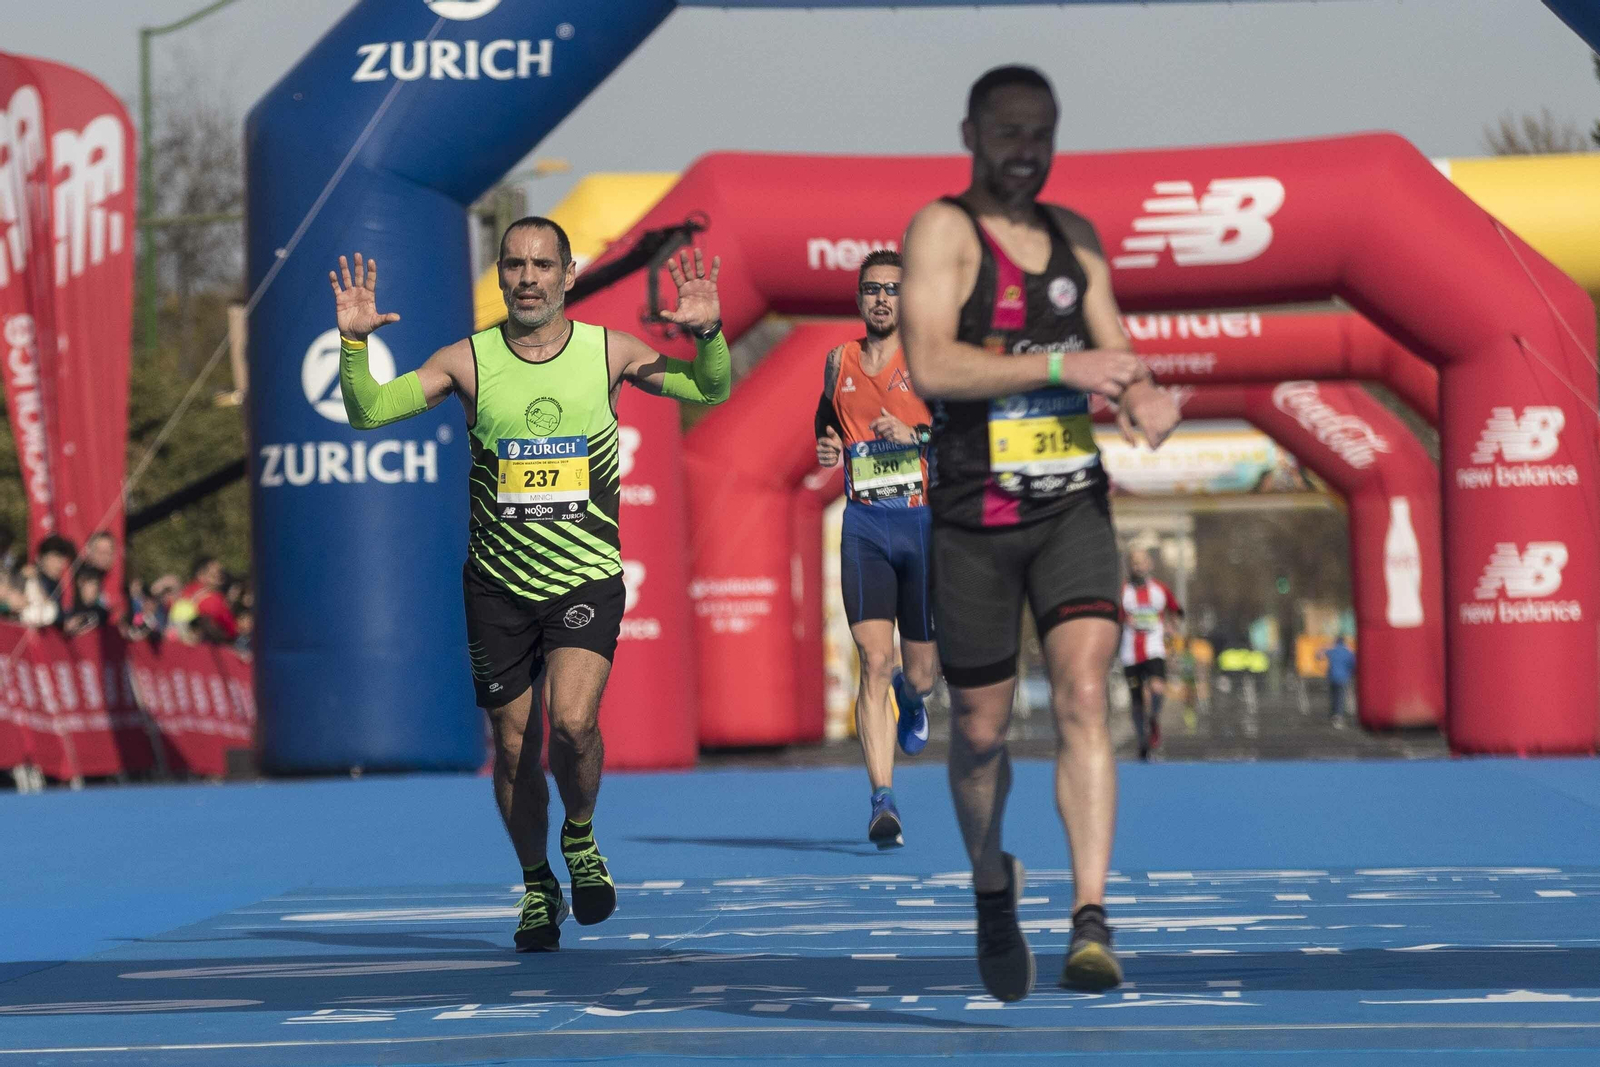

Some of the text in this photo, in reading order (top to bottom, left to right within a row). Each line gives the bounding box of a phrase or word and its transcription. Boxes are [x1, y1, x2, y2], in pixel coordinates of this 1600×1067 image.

[352, 38, 553, 82] ZURICH
[1032, 430, 1073, 454] 319
[1470, 405, 1565, 464] NB
[523, 442, 576, 456] ZURICH
[259, 440, 438, 487] ZURICH
[1456, 463, 1578, 489] new balance
[523, 469, 560, 488] 237
[529, 493, 553, 501] MINICI
[1473, 540, 1568, 600] NB
[1459, 599, 1582, 625] new balance
